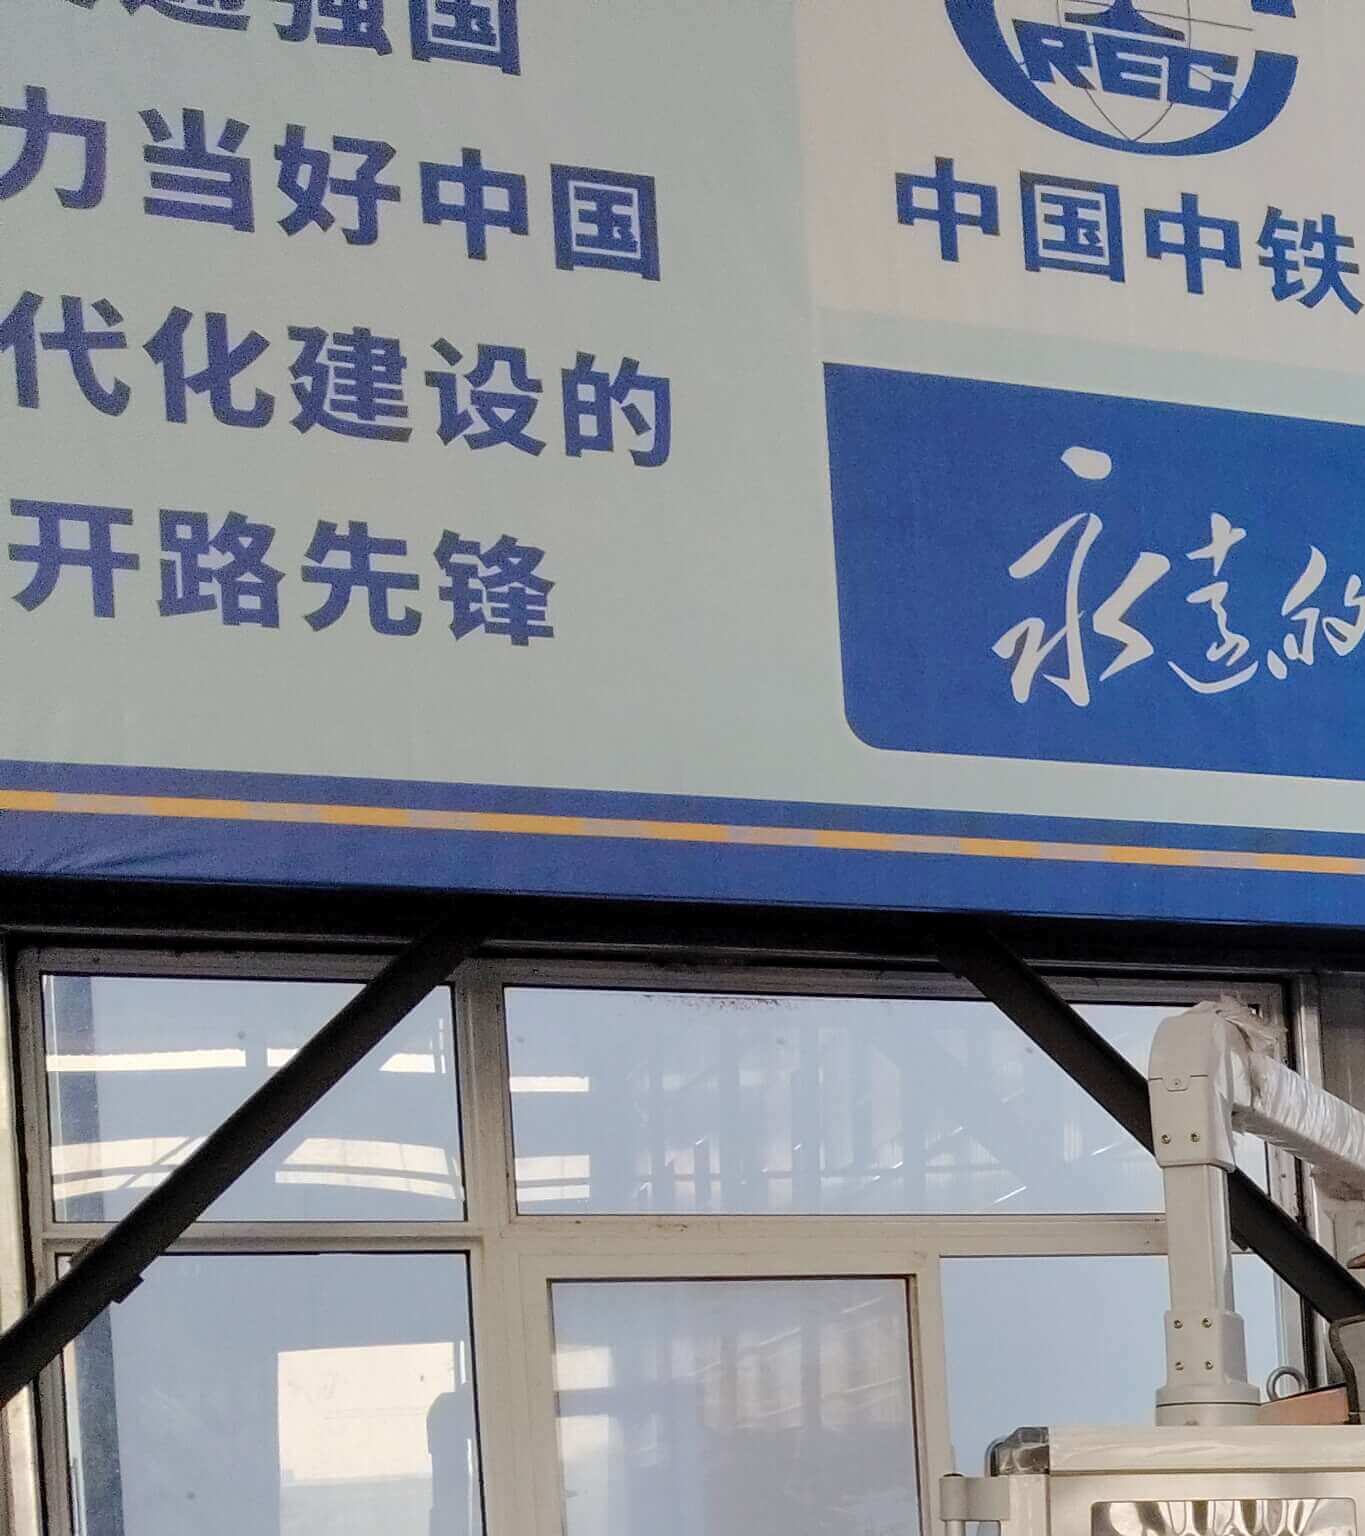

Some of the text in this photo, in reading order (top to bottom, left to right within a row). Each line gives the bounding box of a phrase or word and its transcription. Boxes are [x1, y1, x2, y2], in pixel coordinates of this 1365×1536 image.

[0, 84, 661, 282] 力当好中国
[895, 155, 1364, 315] 中国中铁
[0, 290, 671, 468] 代化建设的
[7, 499, 556, 647] 开路先锋
